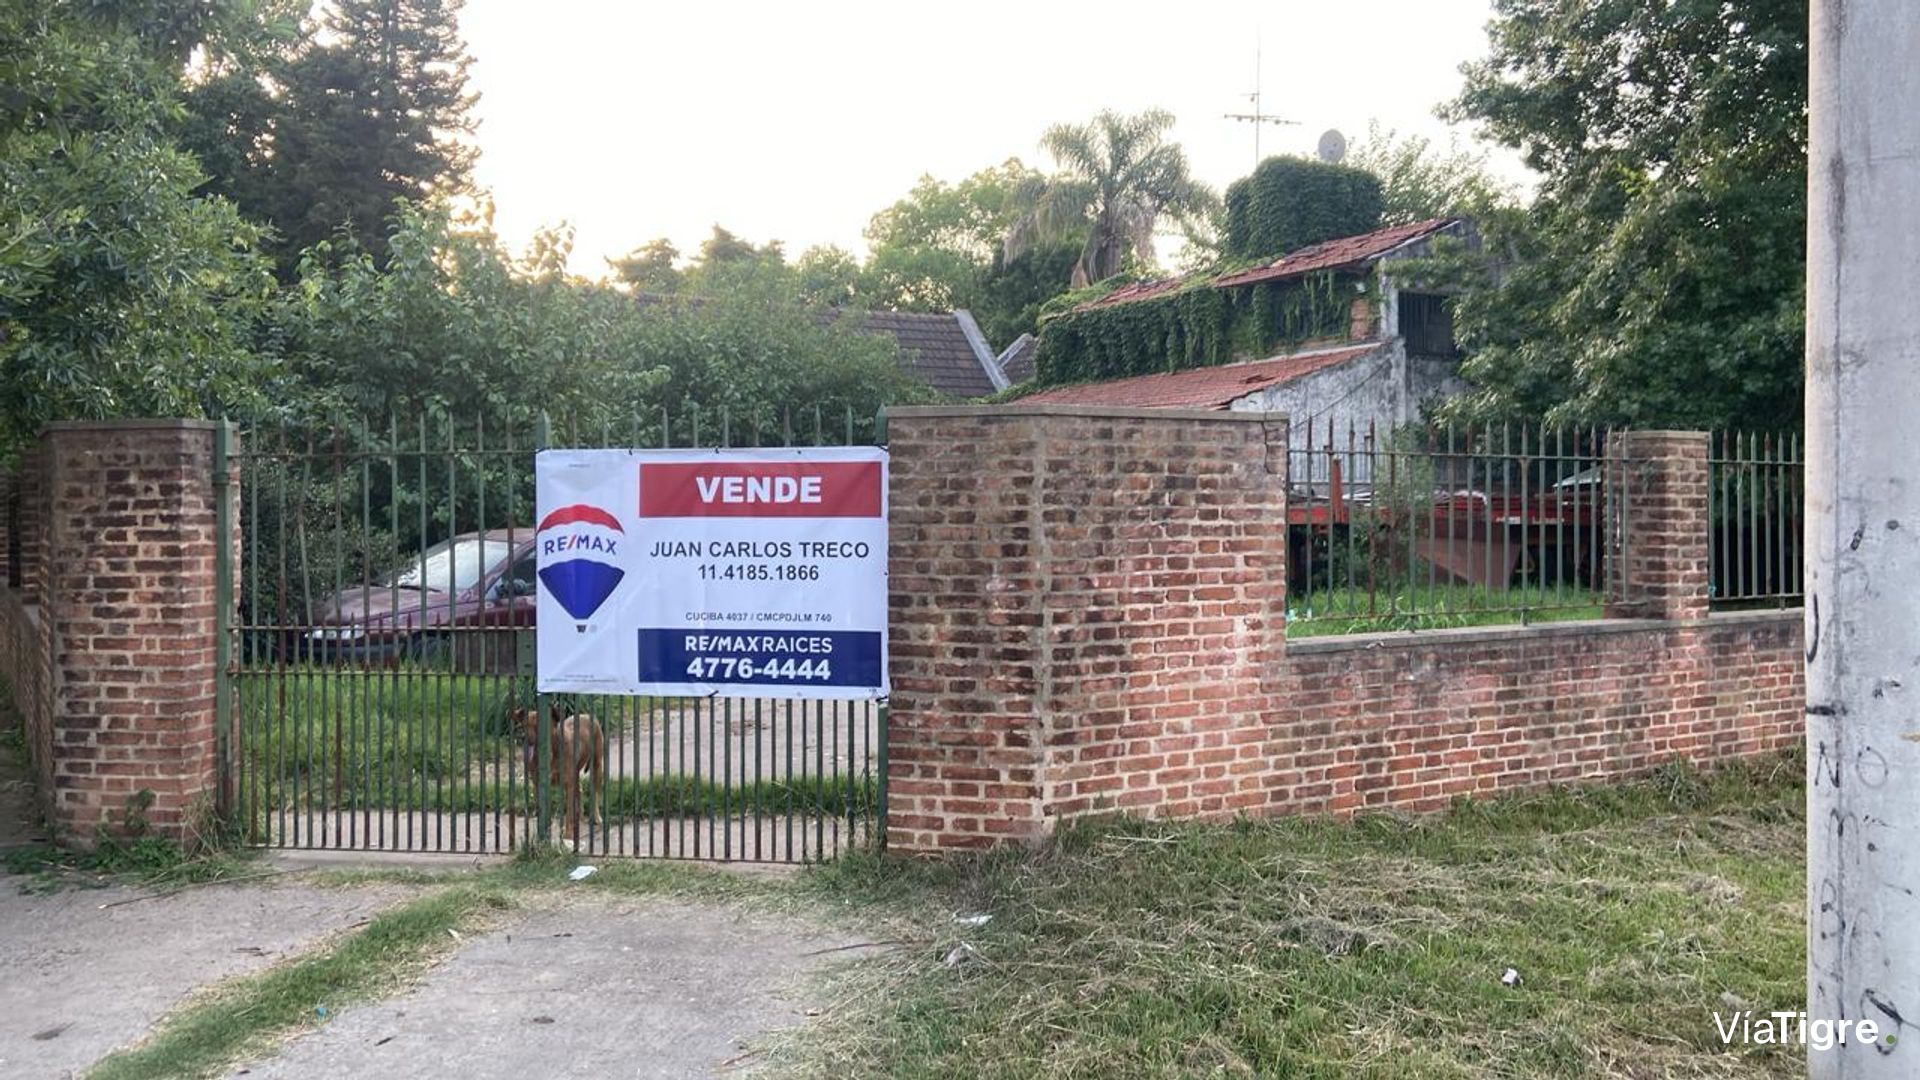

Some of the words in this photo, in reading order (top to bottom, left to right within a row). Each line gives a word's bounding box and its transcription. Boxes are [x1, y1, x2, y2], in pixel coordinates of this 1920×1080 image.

[696, 476, 822, 503] VENDE
[544, 534, 617, 555] RE/MAX
[650, 541, 702, 557] JUAN
[709, 541, 792, 557] CARLOS
[799, 541, 870, 558] TRECO
[698, 564, 819, 581] 11.4185.1866
[685, 612, 724, 621] CUCIBA
[726, 612, 748, 621] 4037
[756, 612, 813, 622] CMCPDJLM
[815, 613, 832, 622] 740
[686, 657, 831, 680] 4776-4444
